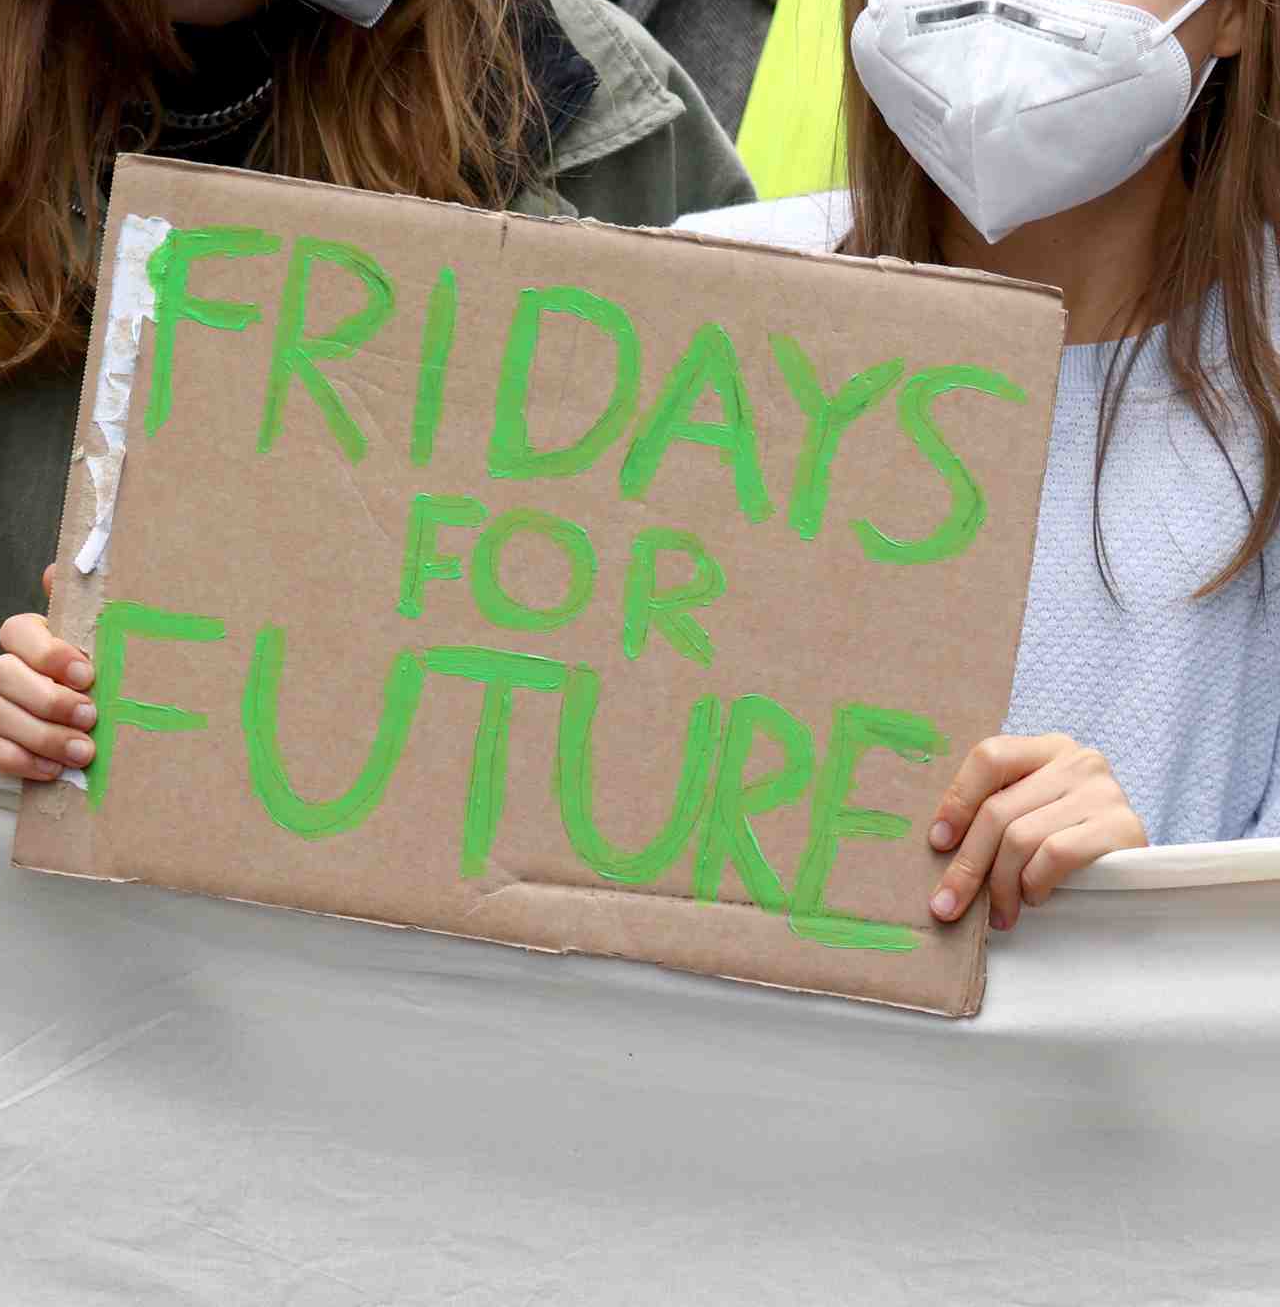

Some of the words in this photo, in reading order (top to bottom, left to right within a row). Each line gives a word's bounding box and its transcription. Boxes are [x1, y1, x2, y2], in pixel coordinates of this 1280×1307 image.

[144, 227, 1027, 566] FRIDAYS
[396, 492, 728, 667] FOR
[86, 600, 951, 953] FUTURE
